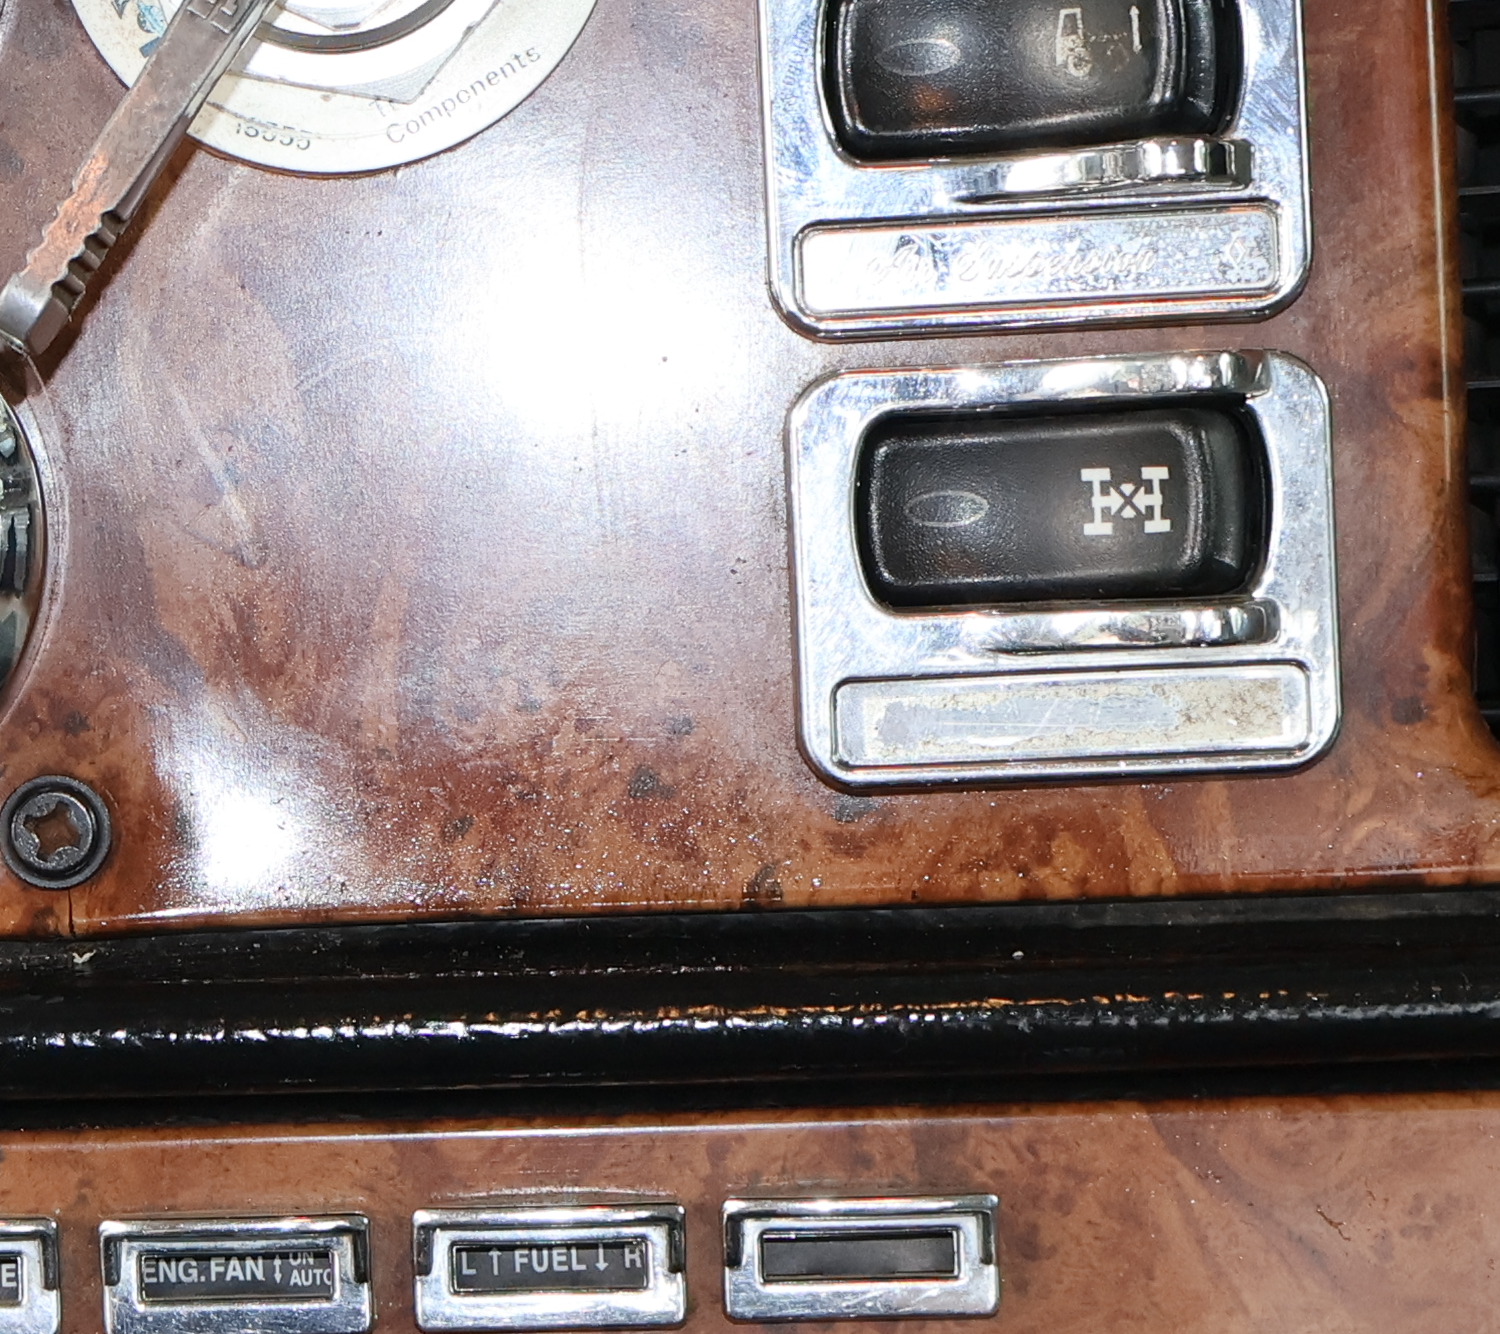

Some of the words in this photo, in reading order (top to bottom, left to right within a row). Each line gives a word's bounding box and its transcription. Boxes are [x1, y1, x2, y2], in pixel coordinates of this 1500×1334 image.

[386, 45, 542, 143] Components
[461, 1251, 477, 1275] L
[514, 1246, 587, 1273] FUEL
